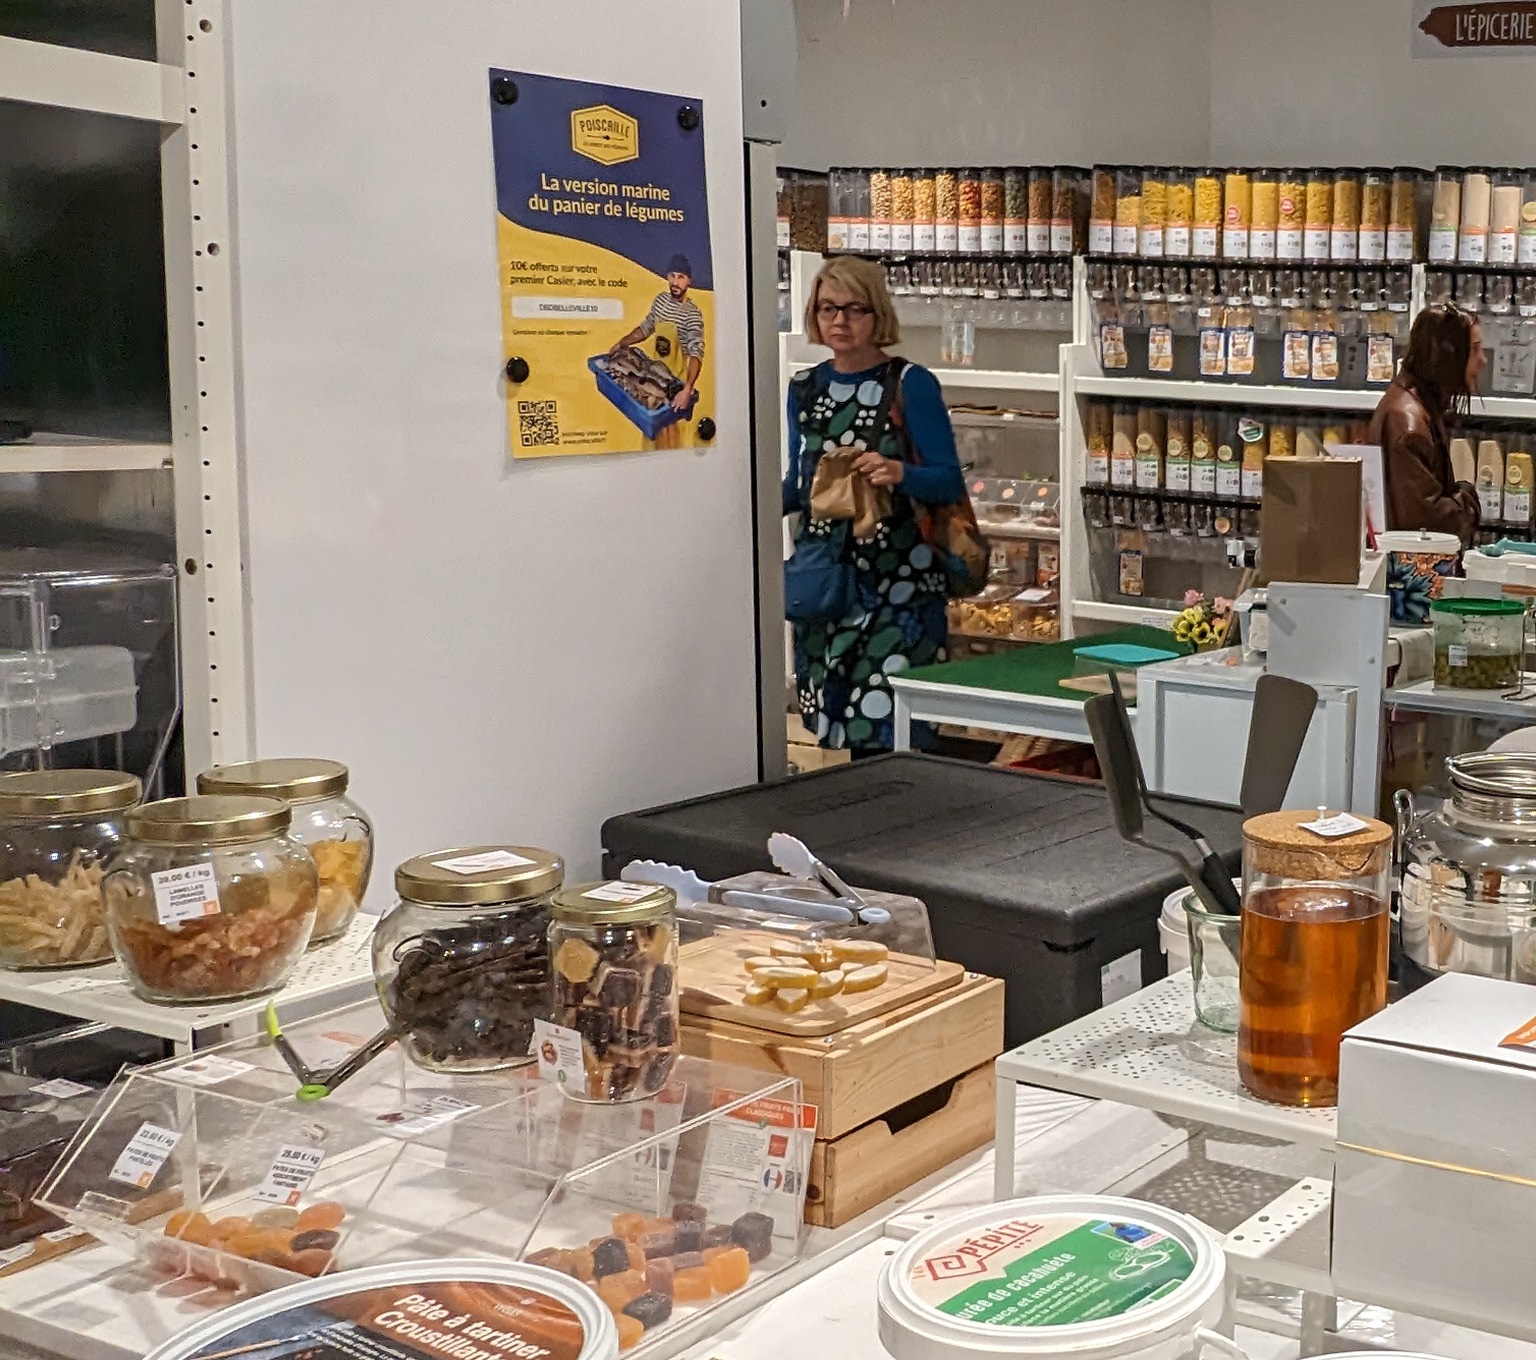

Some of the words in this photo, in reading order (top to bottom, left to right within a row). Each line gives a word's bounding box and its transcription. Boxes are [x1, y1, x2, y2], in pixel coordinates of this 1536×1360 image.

[1454, 7, 1535, 41] L'ÉPICERIE
[579, 117, 630, 139] POISCAILLE
[540, 172, 560, 192] La
[562, 177, 619, 196] version
[621, 182, 671, 201] marine
[528, 193, 549, 212] du
[552, 196, 601, 216] panier
[603, 200, 623, 216] de
[625, 201, 685, 223] légumes
[607, 278, 628, 288] code
[987, 1288, 1012, 1302] de
[1006, 1252, 1077, 1292] cacahuète
[1016, 1293, 1034, 1307] et
[1031, 1271, 1077, 1299] intense
[392, 1293, 451, 1322] Pâte
[443, 1313, 471, 1330] à
[460, 1320, 552, 1360] tartiner
